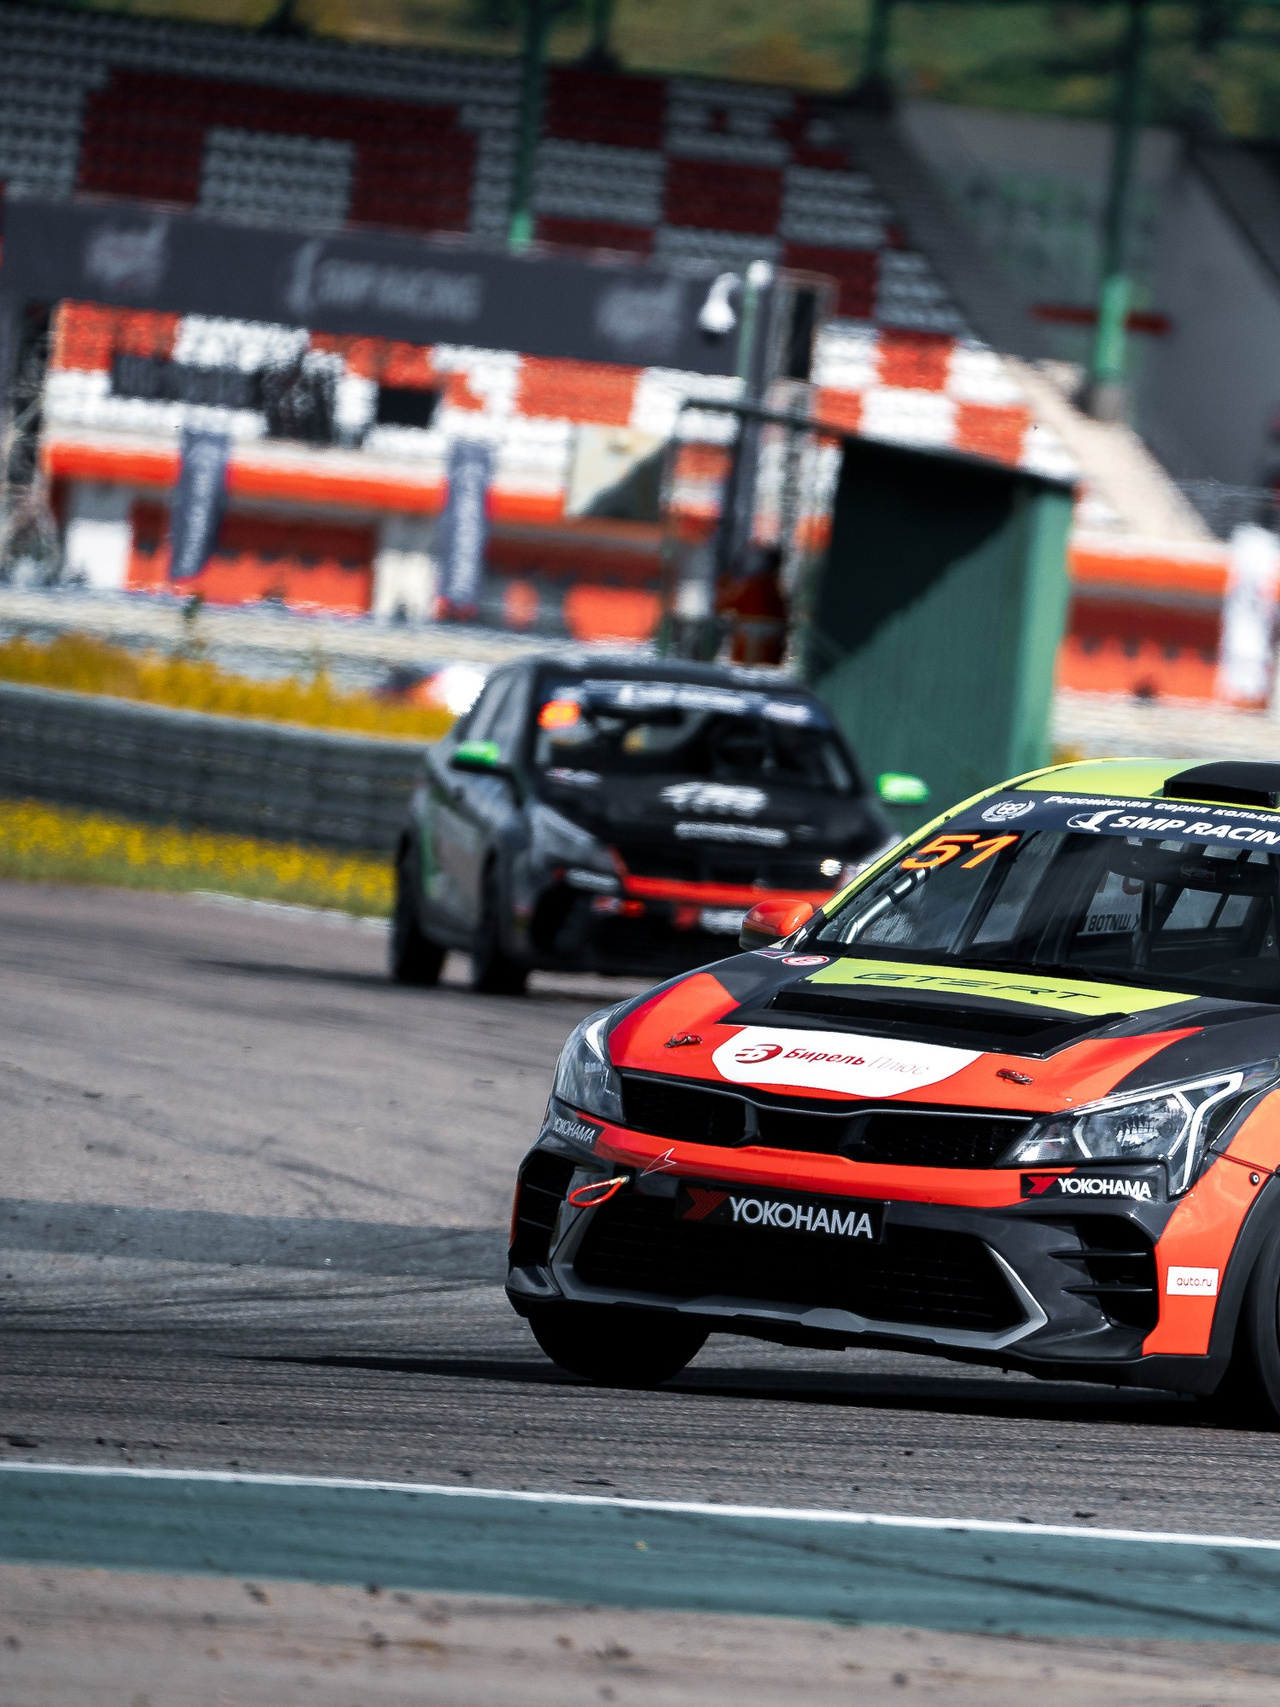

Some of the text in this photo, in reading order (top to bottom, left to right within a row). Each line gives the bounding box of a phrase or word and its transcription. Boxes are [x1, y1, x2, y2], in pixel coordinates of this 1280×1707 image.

[1043, 796, 1152, 809] Российская
[1154, 803, 1207, 814] серия
[1109, 815, 1186, 832] SMP
[900, 834, 1019, 869] 51
[783, 1048, 866, 1067] Бирель
[867, 1056, 930, 1075] Плюс
[1058, 1178, 1152, 1198] YOKOHAMA
[729, 1196, 873, 1239] YOKOHAMA
[1176, 1276, 1212, 1288] auto.ru
